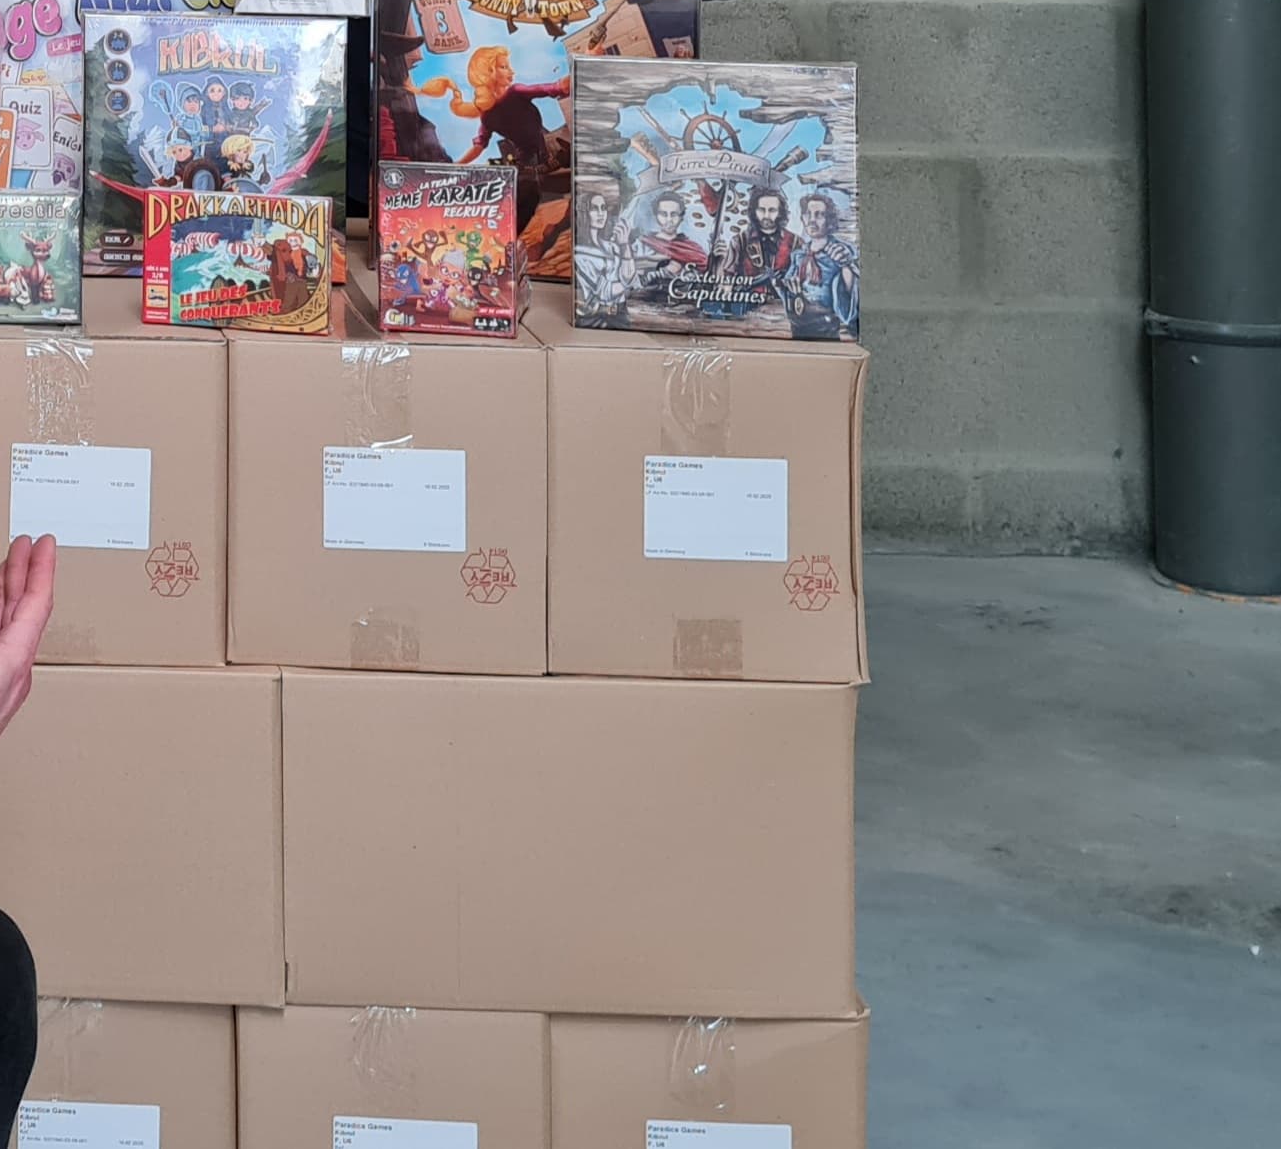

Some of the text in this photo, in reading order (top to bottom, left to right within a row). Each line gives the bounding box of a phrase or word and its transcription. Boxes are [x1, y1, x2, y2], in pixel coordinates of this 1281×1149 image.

[9, 101, 42, 115] Quiz
[665, 153, 705, 173] Terre
[443, 205, 500, 218] RECRUTE
[148, 193, 326, 248] DRAKKARMADA
[680, 262, 753, 285] Extension
[669, 277, 767, 308] Capitaines
[180, 293, 193, 307] LE
[44, 449, 69, 457] Games
[357, 452, 382, 460] Games
[678, 461, 703, 469] Games
[155, 563, 193, 581] REZY
[471, 569, 510, 587] REZY
[793, 575, 833, 594] REZY
[52, 1107, 76, 1115] Games
[367, 1123, 392, 1131] Games
